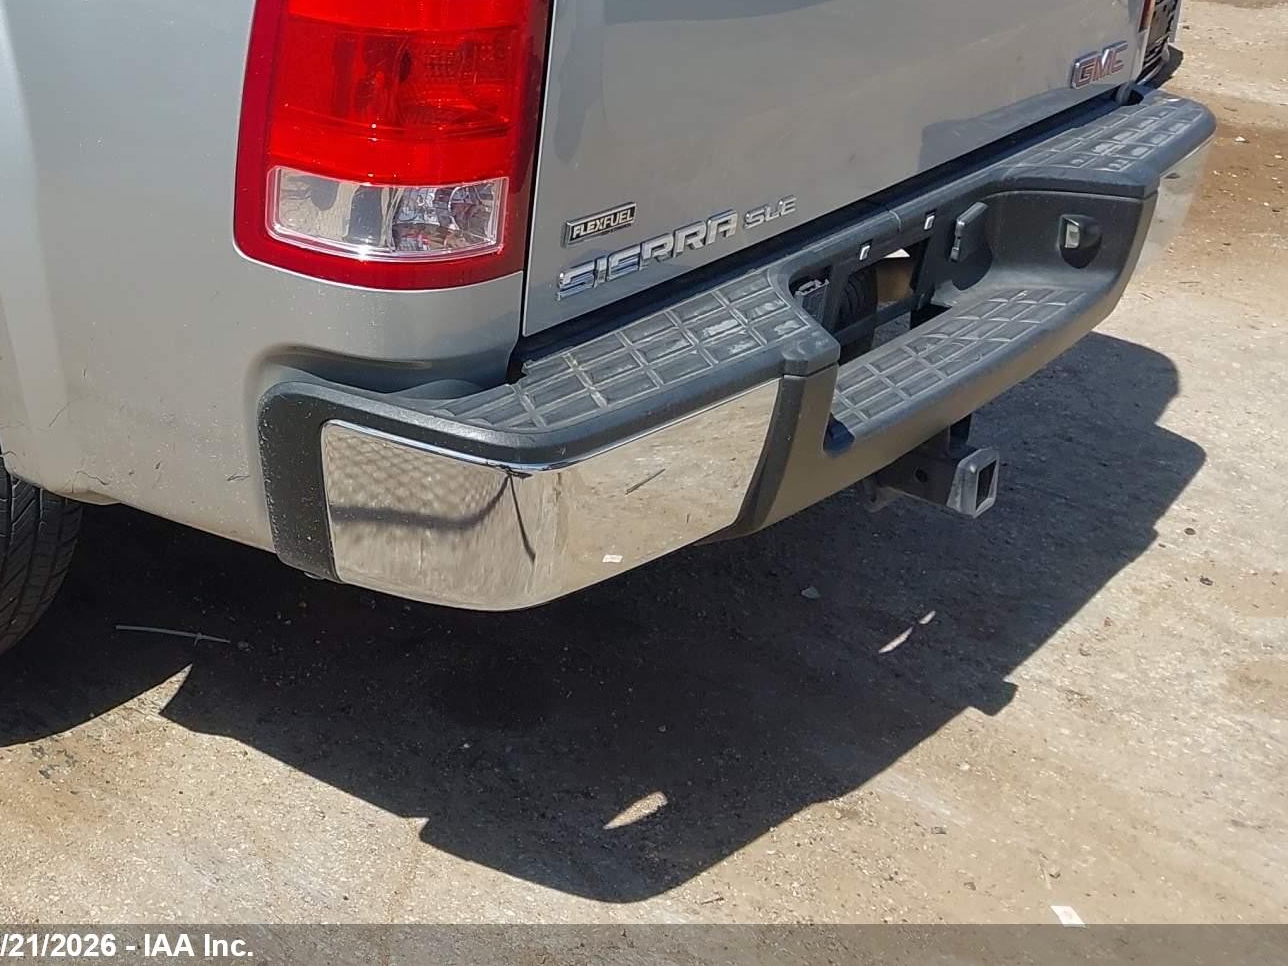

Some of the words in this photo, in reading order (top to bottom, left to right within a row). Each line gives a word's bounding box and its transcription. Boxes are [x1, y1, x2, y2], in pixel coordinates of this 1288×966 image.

[1071, 41, 1128, 89] GMC
[558, 208, 739, 300] SIERRA
[743, 194, 797, 230] SLE
[572, 208, 634, 239] FLEXFUEL
